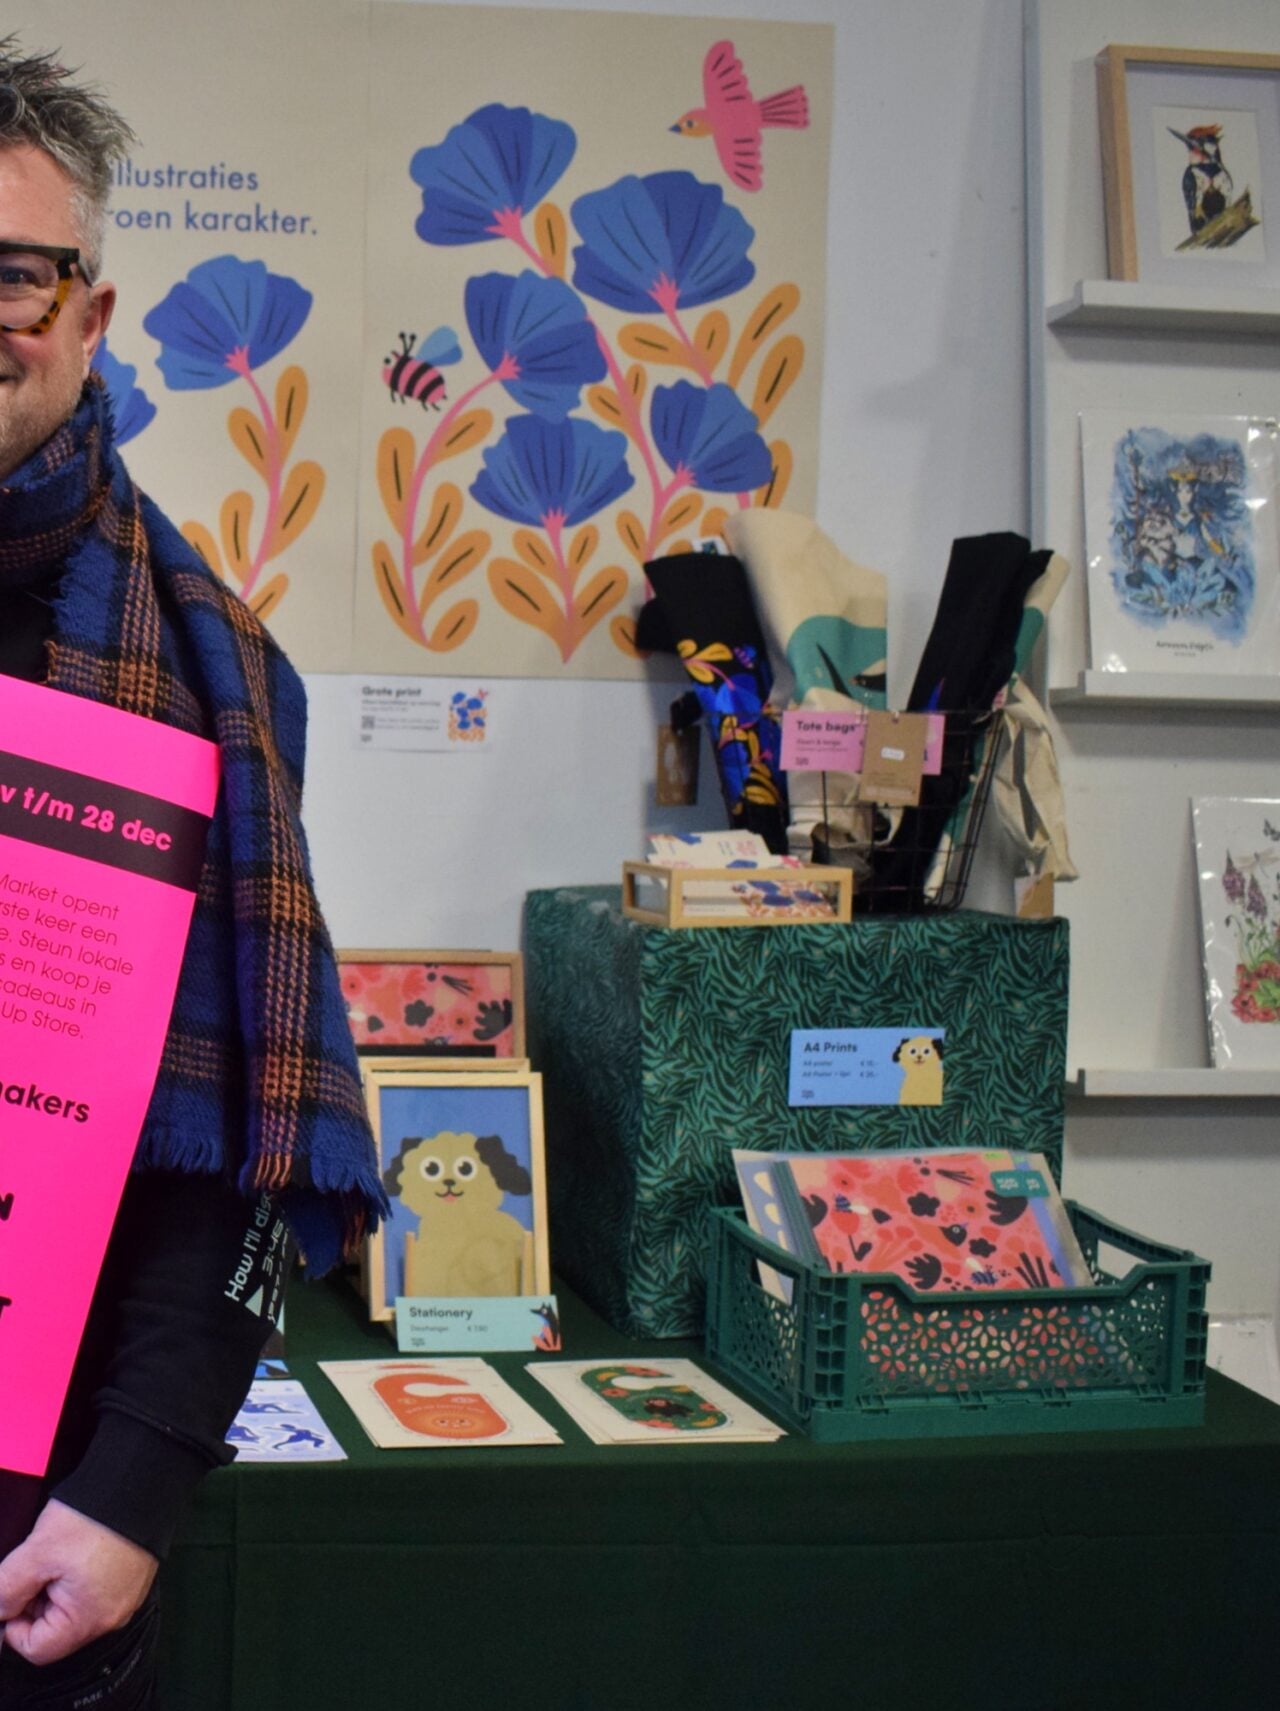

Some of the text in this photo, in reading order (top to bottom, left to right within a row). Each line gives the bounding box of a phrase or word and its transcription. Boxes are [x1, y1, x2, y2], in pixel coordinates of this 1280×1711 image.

[185, 200, 317, 235] karakter.
[362, 685, 421, 699] Grote print
[797, 720, 855, 735] Tote bags
[23, 787, 74, 822] t/m
[81, 805, 114, 833] 28
[121, 819, 172, 850] dec
[62, 892, 119, 921] opent
[35, 909, 77, 933] keer
[81, 926, 118, 946] een
[19, 930, 72, 959] Steun
[78, 946, 134, 976] lokale
[11, 957, 35, 974] en
[41, 961, 89, 991] koop
[91, 975, 111, 995] je
[81, 999, 97, 1017] in
[32, 1010, 84, 1039] Store.
[804, 1042, 858, 1053] A4 Prints
[224, 1253, 254, 1302] How
[244, 1228, 261, 1251] I'll
[410, 1307, 473, 1320] Stationery
